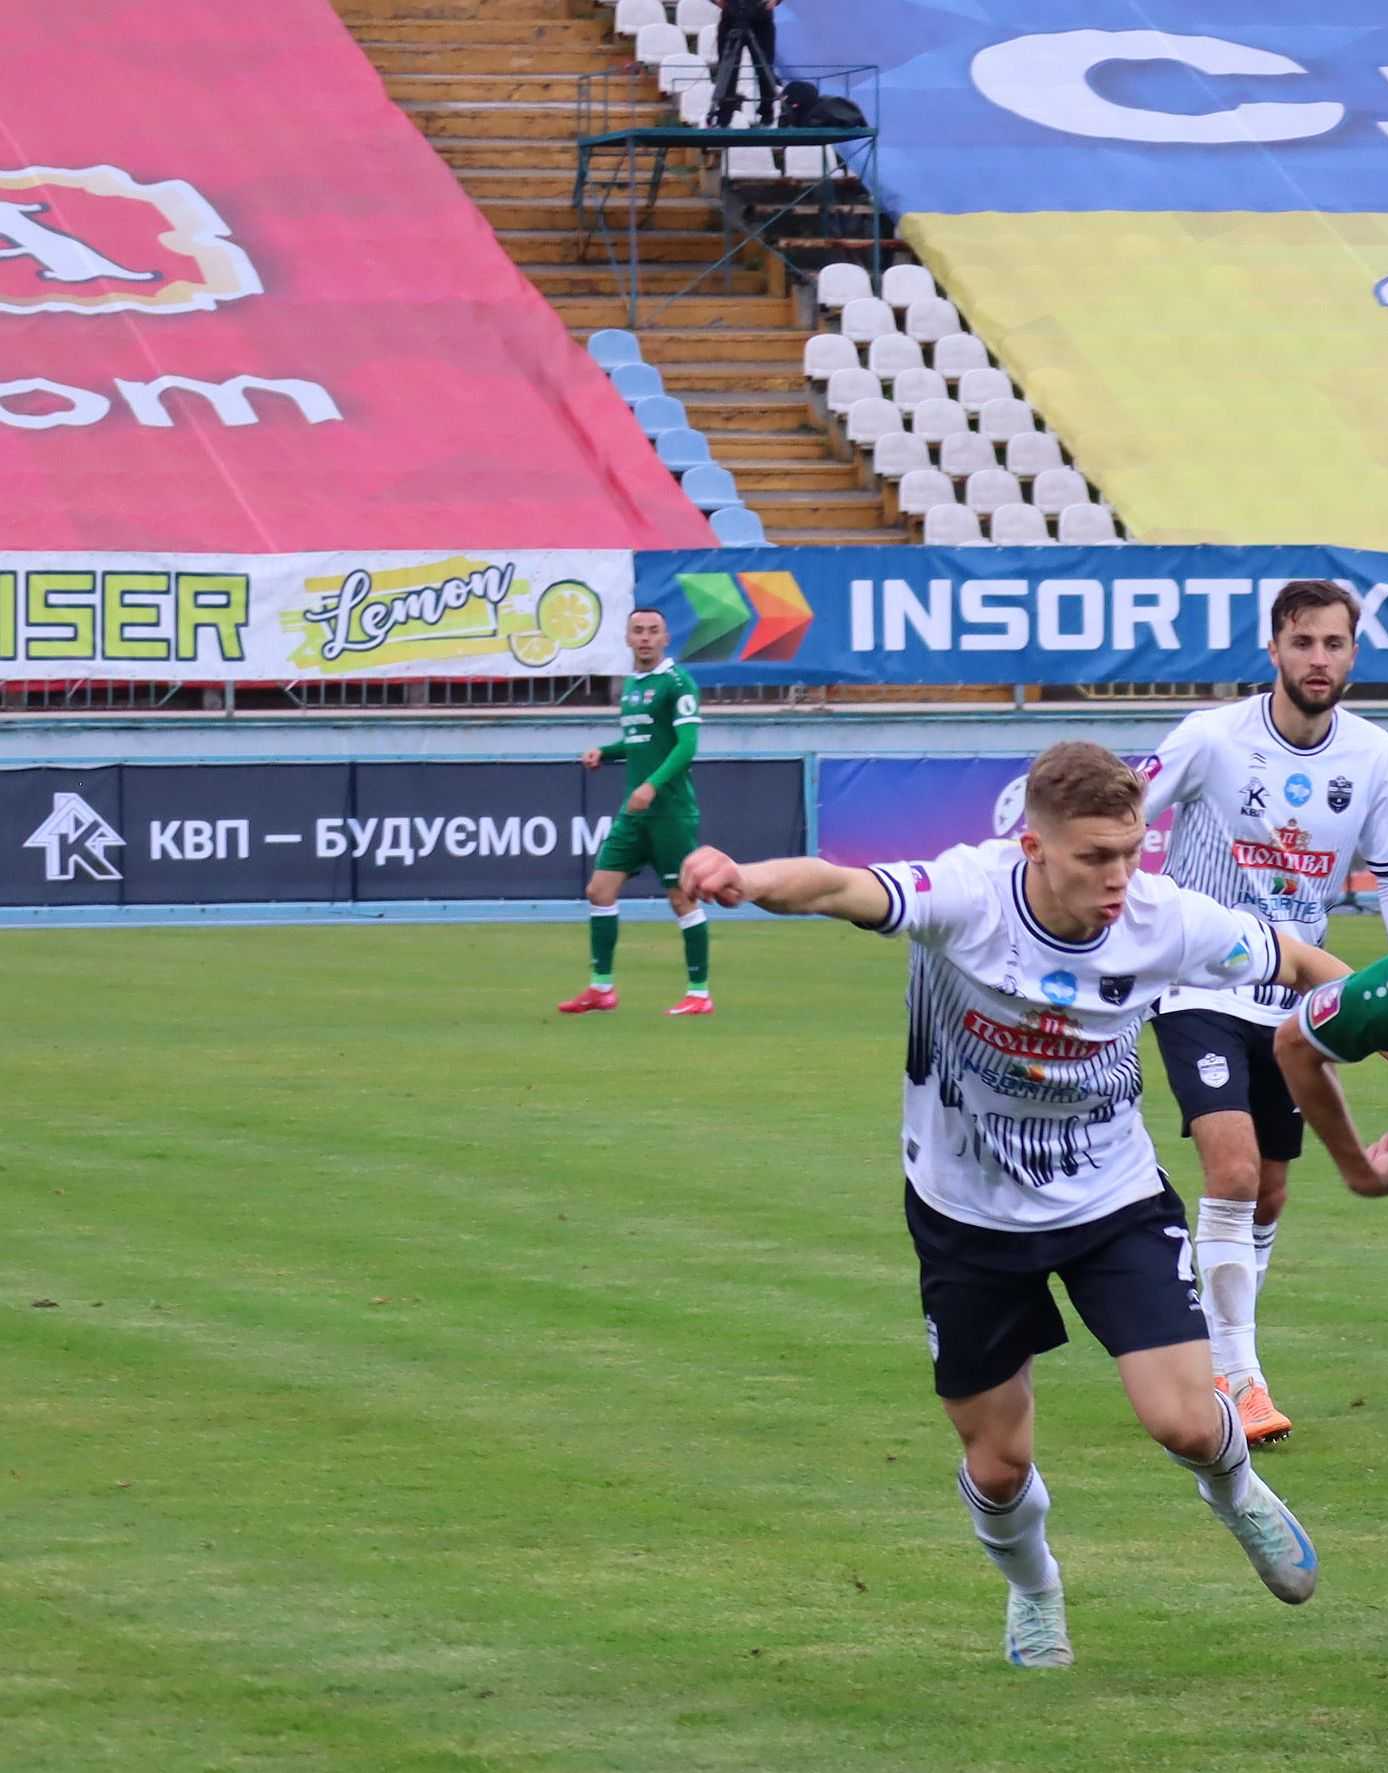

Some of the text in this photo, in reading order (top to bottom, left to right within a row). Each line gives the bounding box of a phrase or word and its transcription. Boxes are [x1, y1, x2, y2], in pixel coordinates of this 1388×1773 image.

[304, 561, 516, 661] Lemon
[150, 820, 250, 861] КВП
[315, 816, 558, 867] БУДУЄМО
